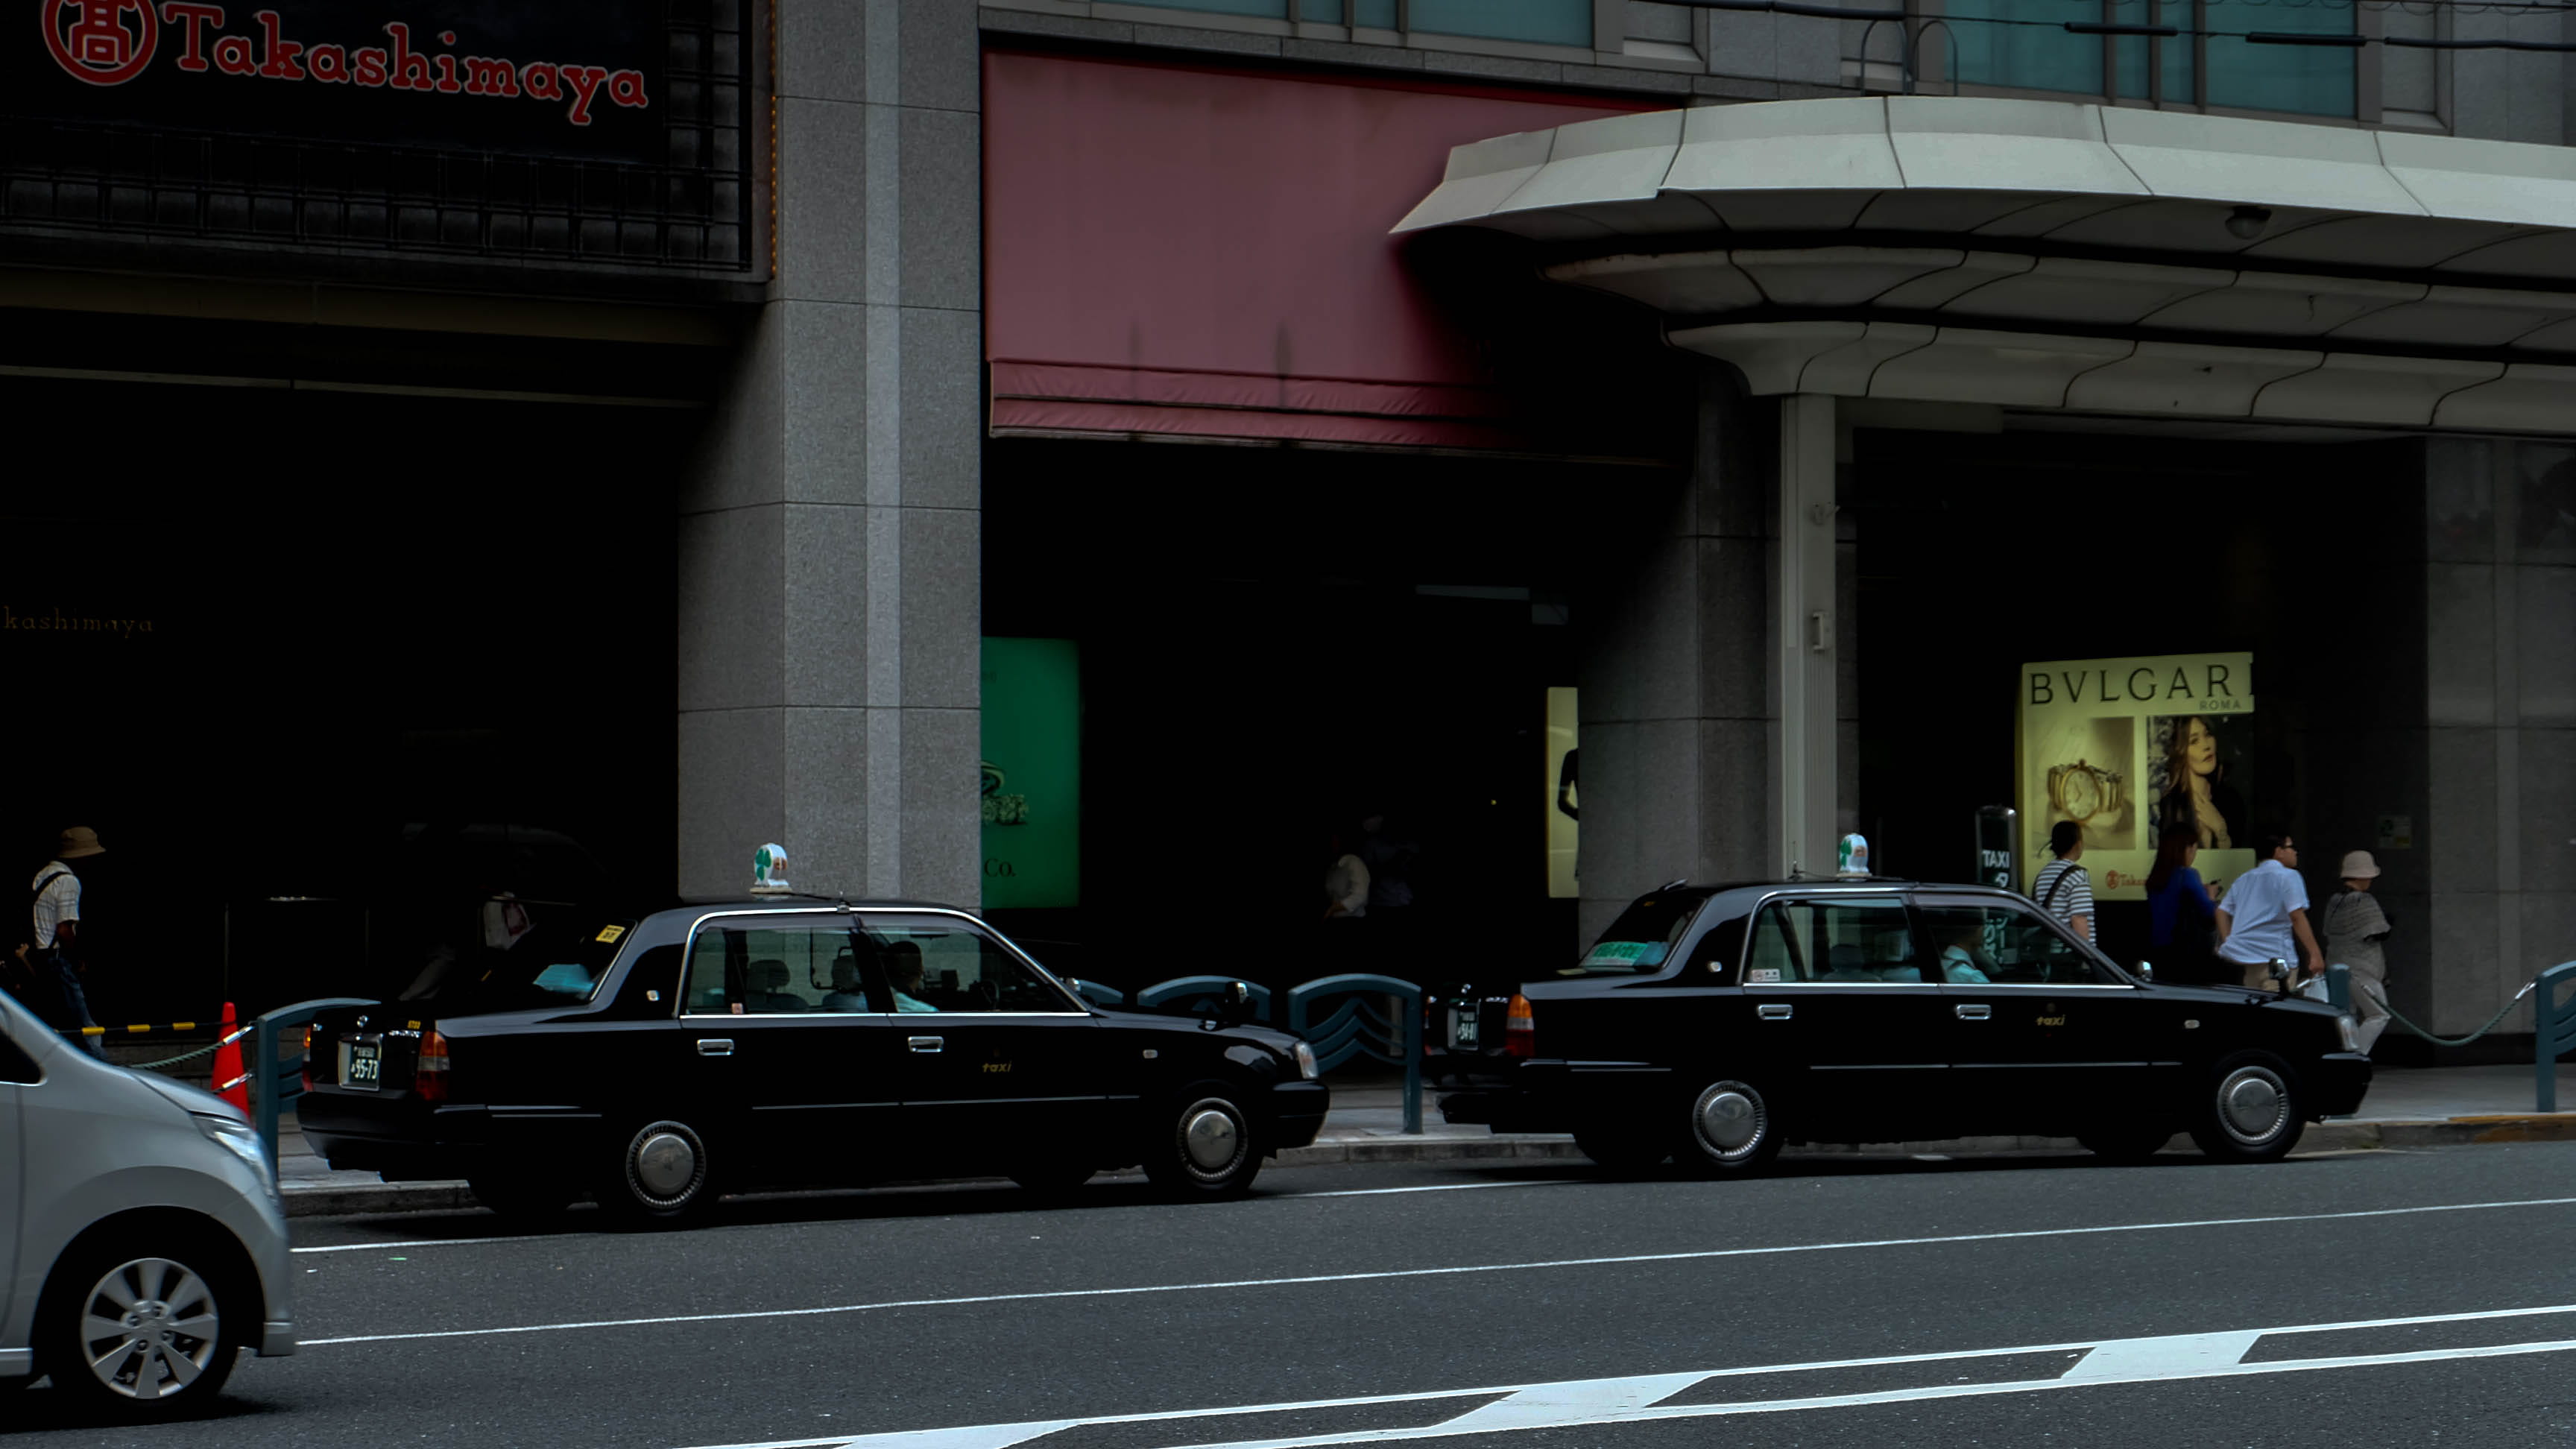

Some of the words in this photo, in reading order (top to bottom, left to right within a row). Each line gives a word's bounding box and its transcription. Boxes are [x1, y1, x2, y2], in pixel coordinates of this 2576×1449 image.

[157, 1, 650, 127] Takashimaya
[0, 603, 155, 640] kashimaya
[2199, 698, 2242, 710] ROMA
[984, 857, 1017, 877] Co.
[1982, 849, 2010, 868] TAXI
[2035, 1013, 2068, 1026] taxi
[982, 1060, 1013, 1073] taxi
